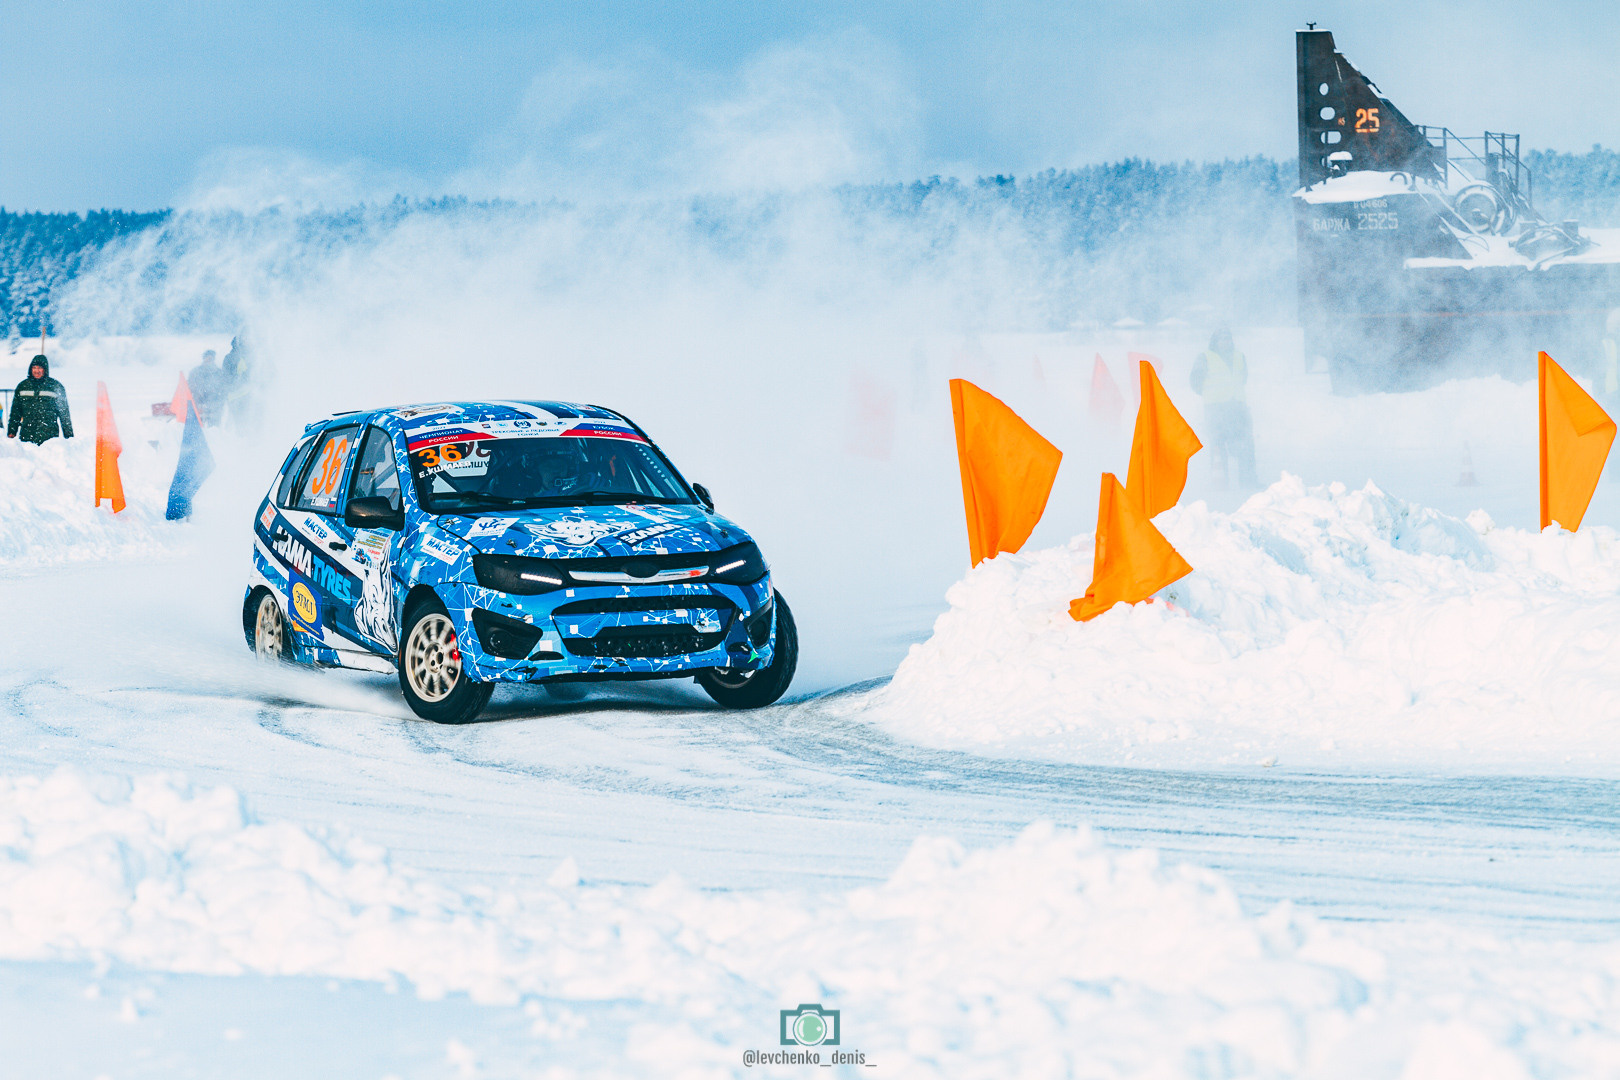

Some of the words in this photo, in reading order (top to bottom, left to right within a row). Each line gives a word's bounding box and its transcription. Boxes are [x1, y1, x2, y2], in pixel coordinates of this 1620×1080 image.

[1355, 108, 1380, 133] 25
[1312, 217, 1351, 232] БАРЖА
[1357, 212, 1399, 230] 2525
[419, 429, 463, 440] ЧЕМПИОНАТ
[311, 438, 348, 495] 36
[418, 444, 462, 467] 36
[304, 517, 328, 539] МАСТЕР
[426, 538, 460, 556] МАСТЕР
[312, 554, 351, 605] TYRES
